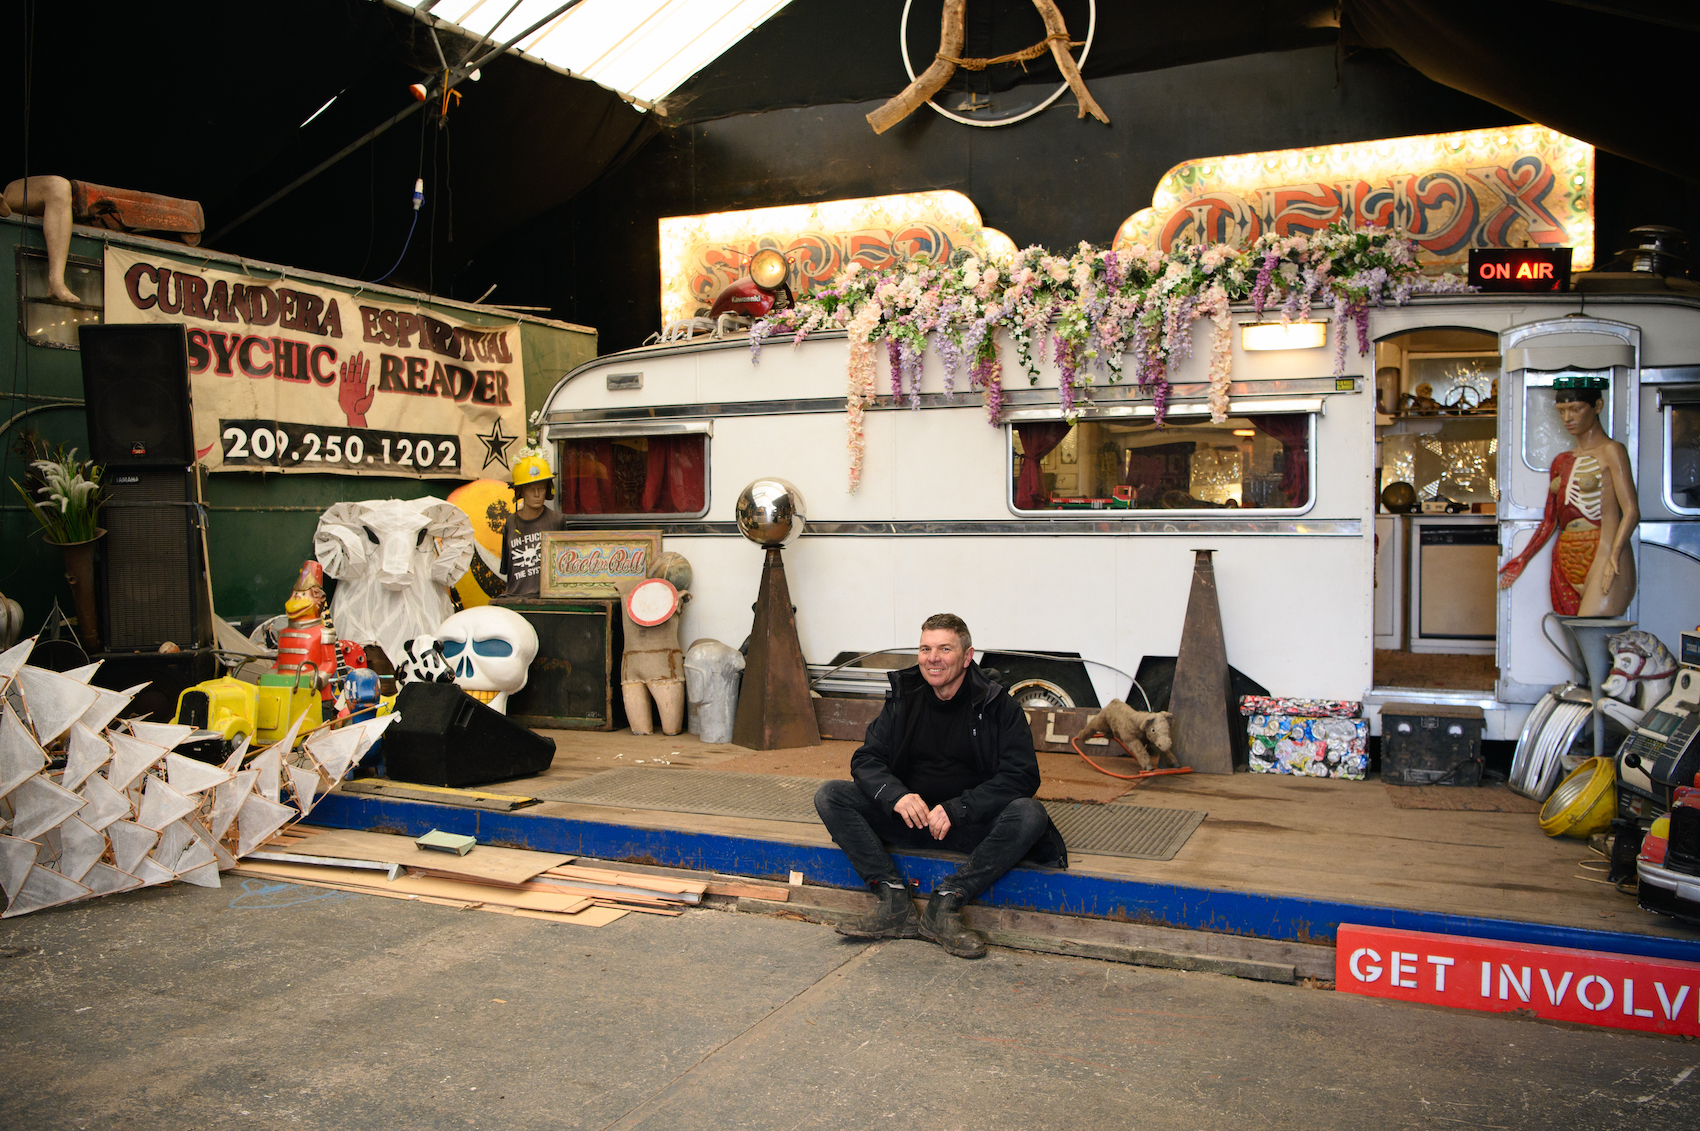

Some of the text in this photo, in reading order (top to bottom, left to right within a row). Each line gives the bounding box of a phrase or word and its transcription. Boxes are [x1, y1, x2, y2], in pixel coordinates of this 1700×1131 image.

[1479, 262, 1554, 280] ON AIR
[124, 262, 513, 364] CURANDERA ESPIRITUAL
[187, 327, 513, 407] SYCHIC READER
[222, 427, 457, 467] 209.250.1202
[514, 569, 527, 580] THE
[1349, 947, 1700, 1023] GET INVOLV
